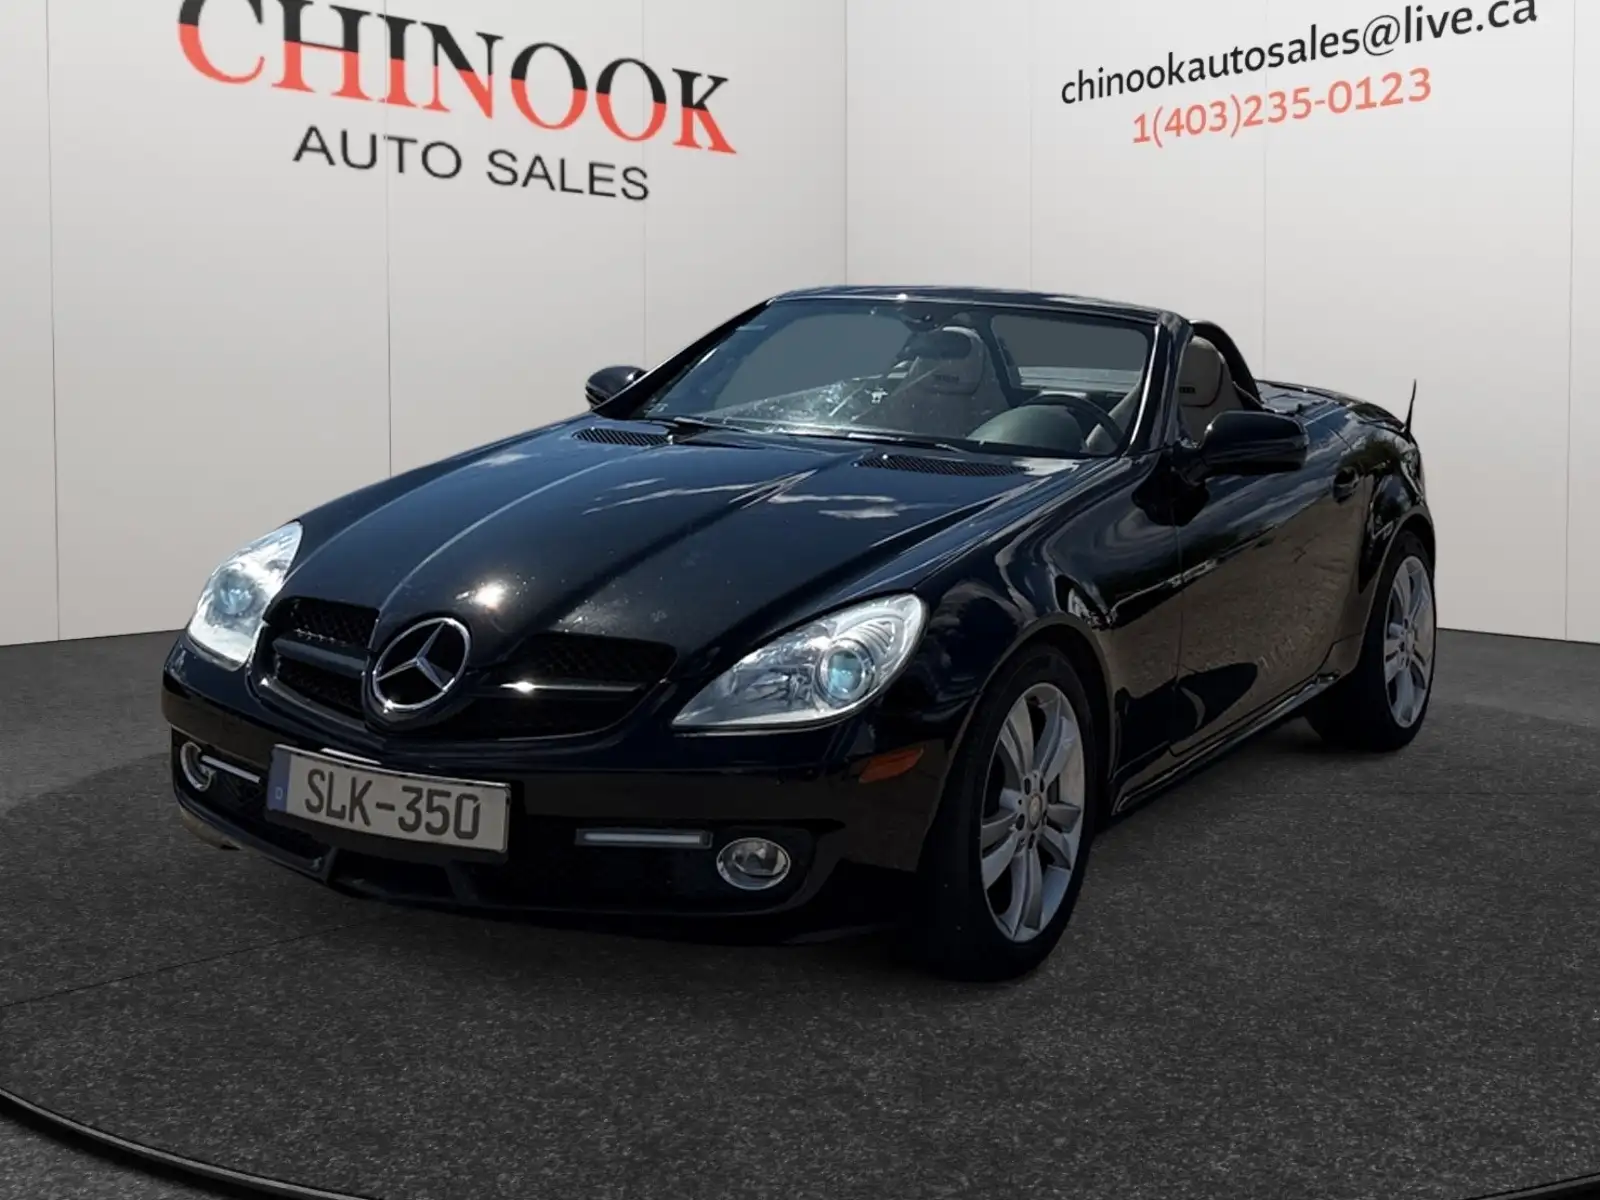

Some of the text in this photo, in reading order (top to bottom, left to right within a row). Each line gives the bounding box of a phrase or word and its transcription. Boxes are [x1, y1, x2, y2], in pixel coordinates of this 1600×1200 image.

[178, 0, 738, 155] CHINOOK
[1061, 0, 1538, 104] chinookautosales@live.ca
[1131, 67, 1432, 148] 1(403)235-0123
[293, 125, 650, 201] AUTO SALES
[304, 768, 482, 840] SLK-350
